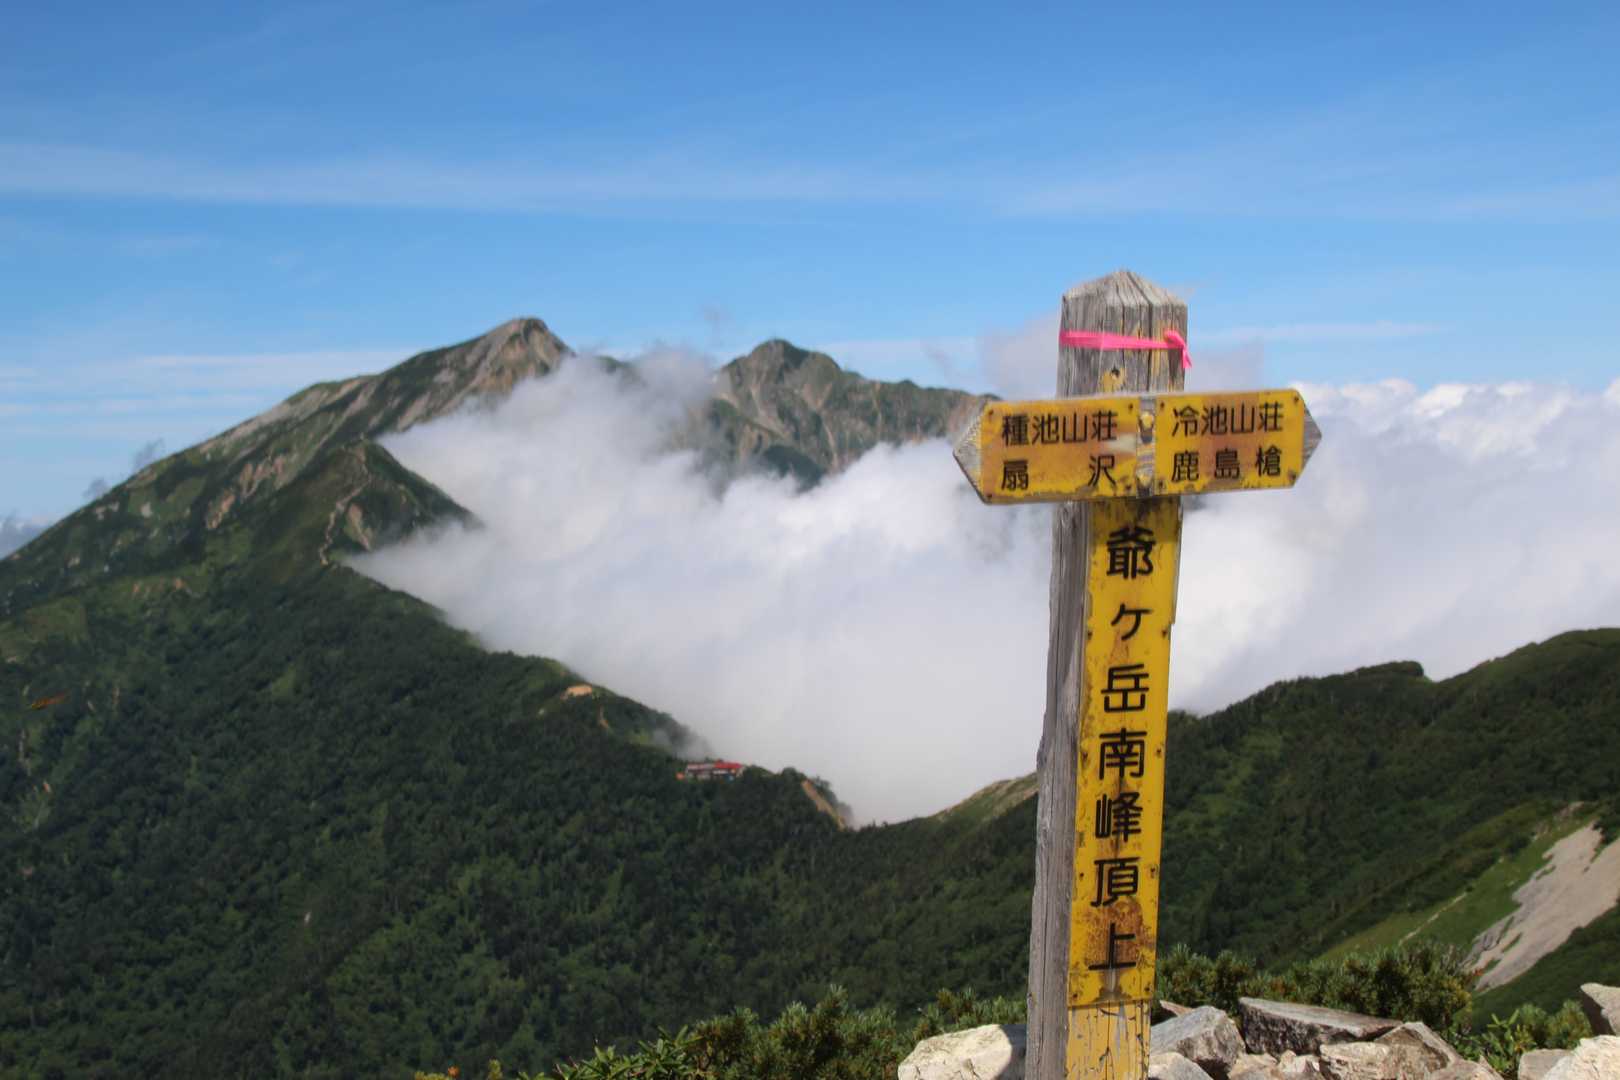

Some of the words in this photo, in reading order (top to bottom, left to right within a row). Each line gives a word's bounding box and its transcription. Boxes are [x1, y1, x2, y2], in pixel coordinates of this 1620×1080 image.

[1001, 410, 1118, 447] 種池山荘
[1171, 402, 1284, 437] 冷池山荘
[1171, 446, 1282, 483] 鹿島槍
